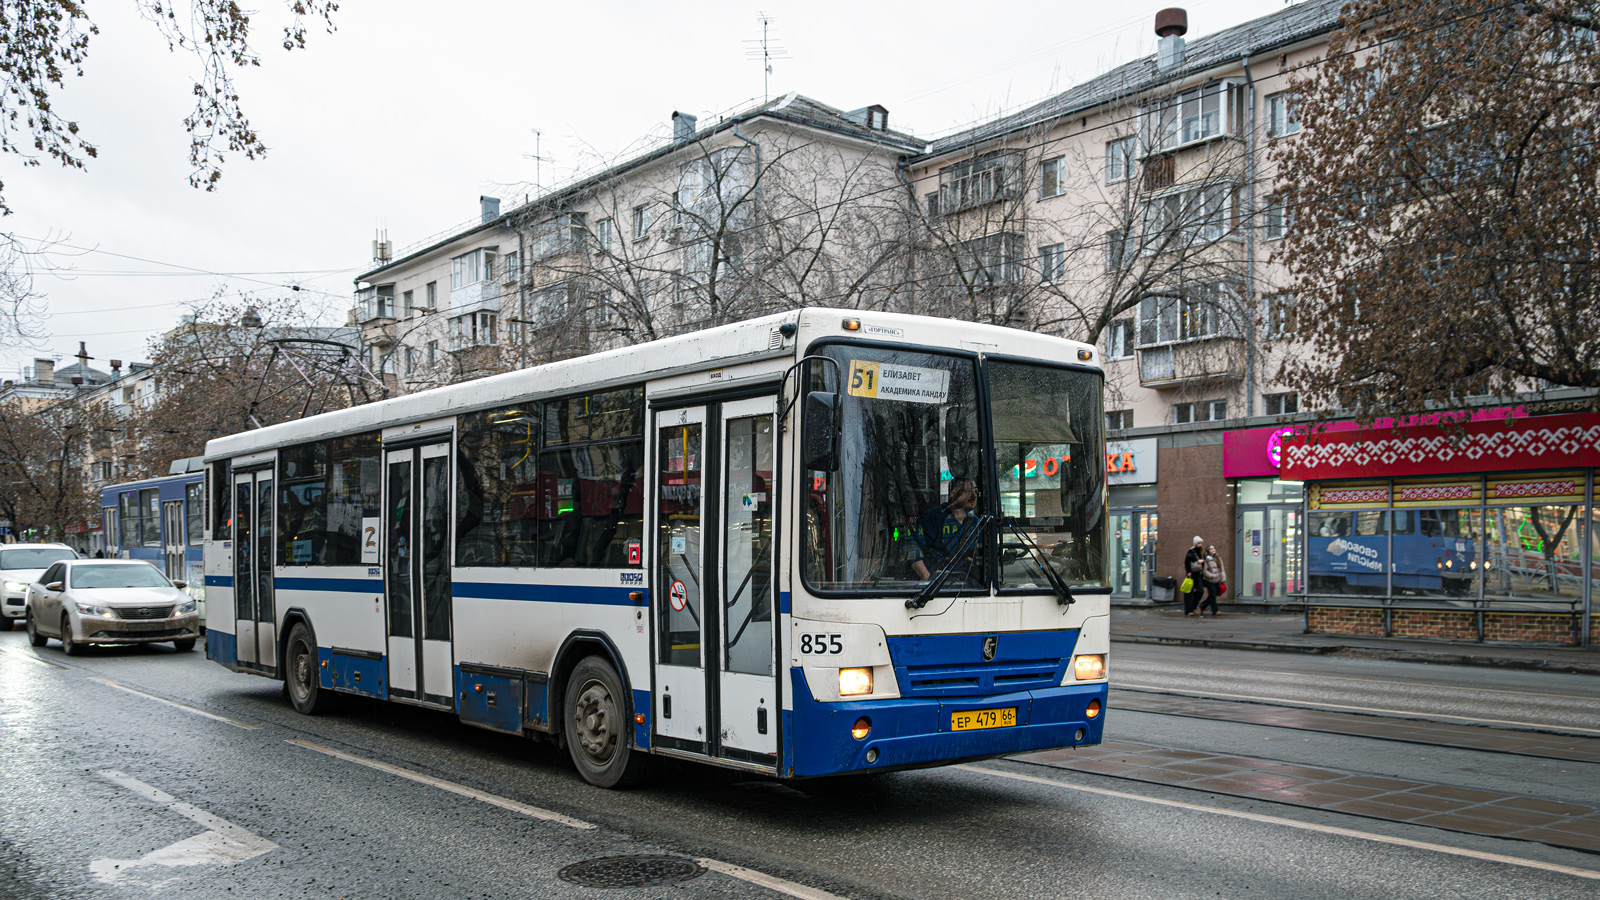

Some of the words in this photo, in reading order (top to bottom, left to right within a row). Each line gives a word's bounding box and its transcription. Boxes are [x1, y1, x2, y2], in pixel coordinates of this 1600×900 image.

[851, 368, 874, 390] 51
[883, 369, 922, 381] ЕЛИЗАВЕТ
[880, 386, 921, 397] АКАДЕМИКА
[920, 389, 947, 399] ЛАНДАУ
[800, 634, 843, 654] 855
[957, 717, 971, 728] ЕР
[976, 711, 997, 726] 479
[1002, 710, 1012, 720] 66
